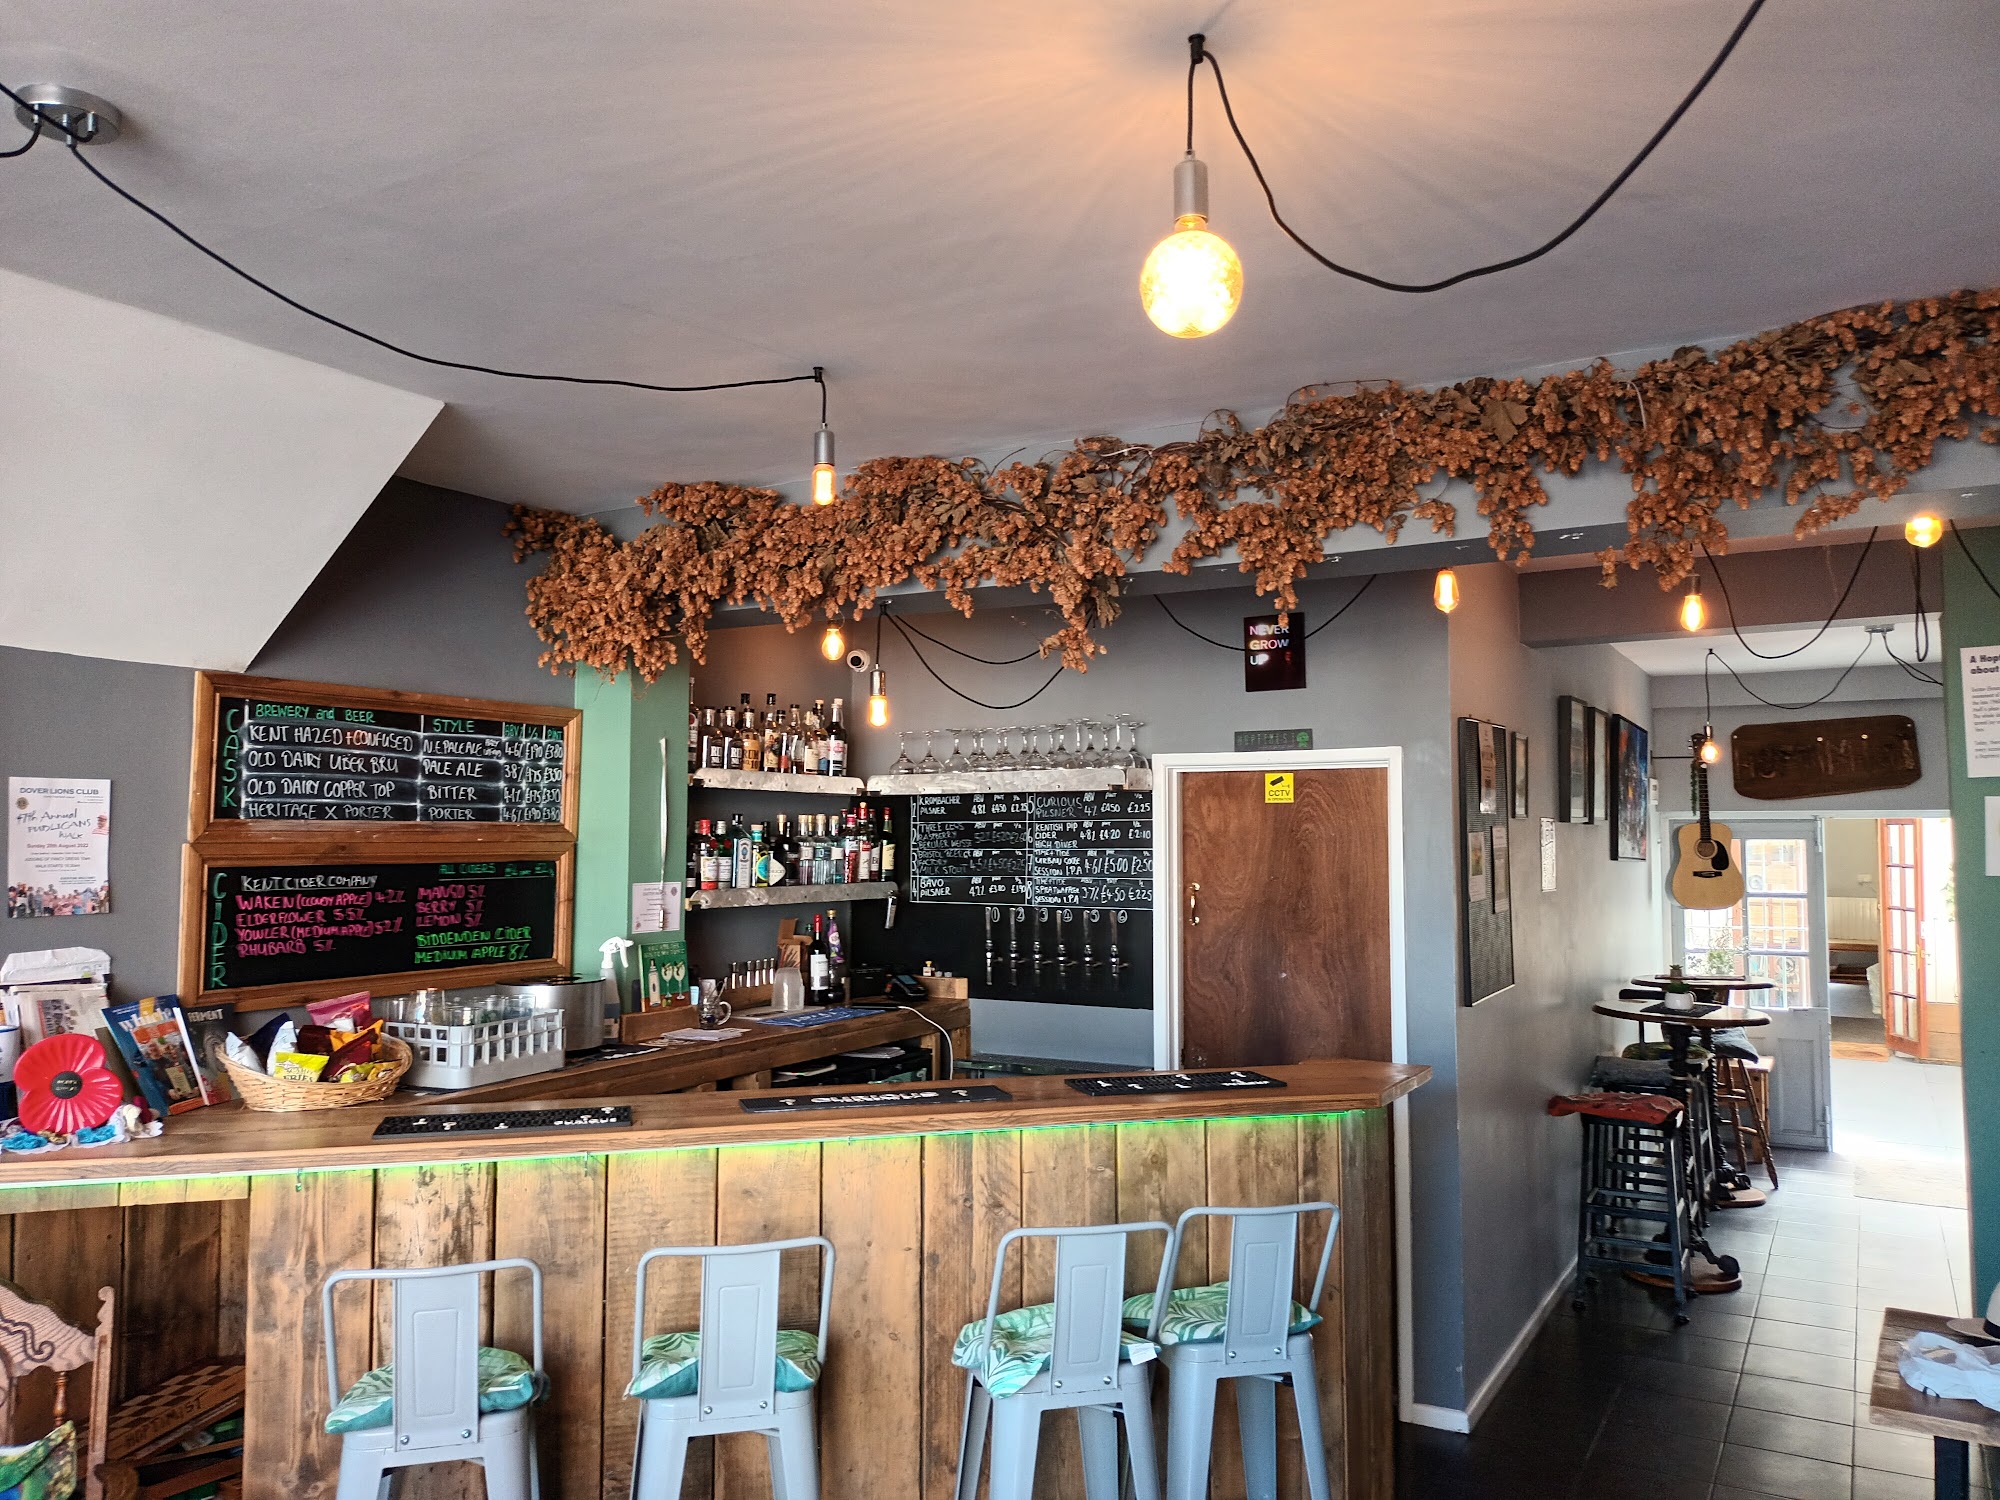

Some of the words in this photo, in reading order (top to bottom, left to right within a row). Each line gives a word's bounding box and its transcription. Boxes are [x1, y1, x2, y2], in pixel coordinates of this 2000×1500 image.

[1249, 639, 1290, 650] GROW
[1250, 654, 1269, 665] UP
[1970, 666, 1999, 674] about
[255, 704, 310, 719] BREWERY
[315, 708, 335, 720] and
[344, 710, 376, 723] BEER
[433, 719, 475, 733] STYLE
[249, 725, 289, 742] KENT
[294, 727, 343, 745] HAZED
[248, 750, 276, 767] OLD
[281, 750, 321, 769] DAIRY
[370, 756, 399, 774] BRU
[422, 759, 452, 776] PALE
[455, 762, 484, 777] ALE
[247, 778, 276, 795] OLD
[281, 778, 320, 795] DAIRY
[323, 781, 368, 798] COPPER
[370, 781, 396, 799] TOP
[919, 795, 962, 805] KROMBACHER
[1036, 796, 1083, 809] CURIOUS
[248, 804, 317, 819] HERITAGE
[324, 805, 338, 820] X
[343, 804, 394, 819] PORTER
[428, 807, 476, 820] PORTER
[920, 806, 947, 815] PILSNER
[1035, 807, 1076, 818] PILSNER
[1035, 823, 1063, 832] KENTISH
[1066, 822, 1078, 832] PIP
[1035, 831, 1057, 840] CIDER
[1035, 840, 1053, 849] HIGH
[919, 867, 940, 876] MILK
[942, 866, 967, 875] STOUT
[1034, 867, 1063, 877] SESSION
[241, 876, 283, 891] KENT
[283, 876, 327, 889] CIDER
[327, 875, 378, 888] COMPANY
[920, 878, 944, 888] BAVO
[417, 884, 465, 900] MANGO
[920, 887, 952, 898] PILSNER
[1034, 895, 1061, 904] SESSION
[415, 900, 457, 913] BERRY
[235, 910, 327, 927] ELDERFLOWER
[415, 913, 461, 927] LEMON
[234, 925, 290, 941] YOWLER
[415, 930, 491, 946] BIDDENDEN
[494, 926, 532, 940] CIDER
[236, 939, 307, 957] RHUBARB
[414, 949, 468, 963] MEDIUM
[471, 945, 507, 958] APPLE
[508, 943, 530, 960] 8%
[187, 1008, 224, 1022] FERMENT
